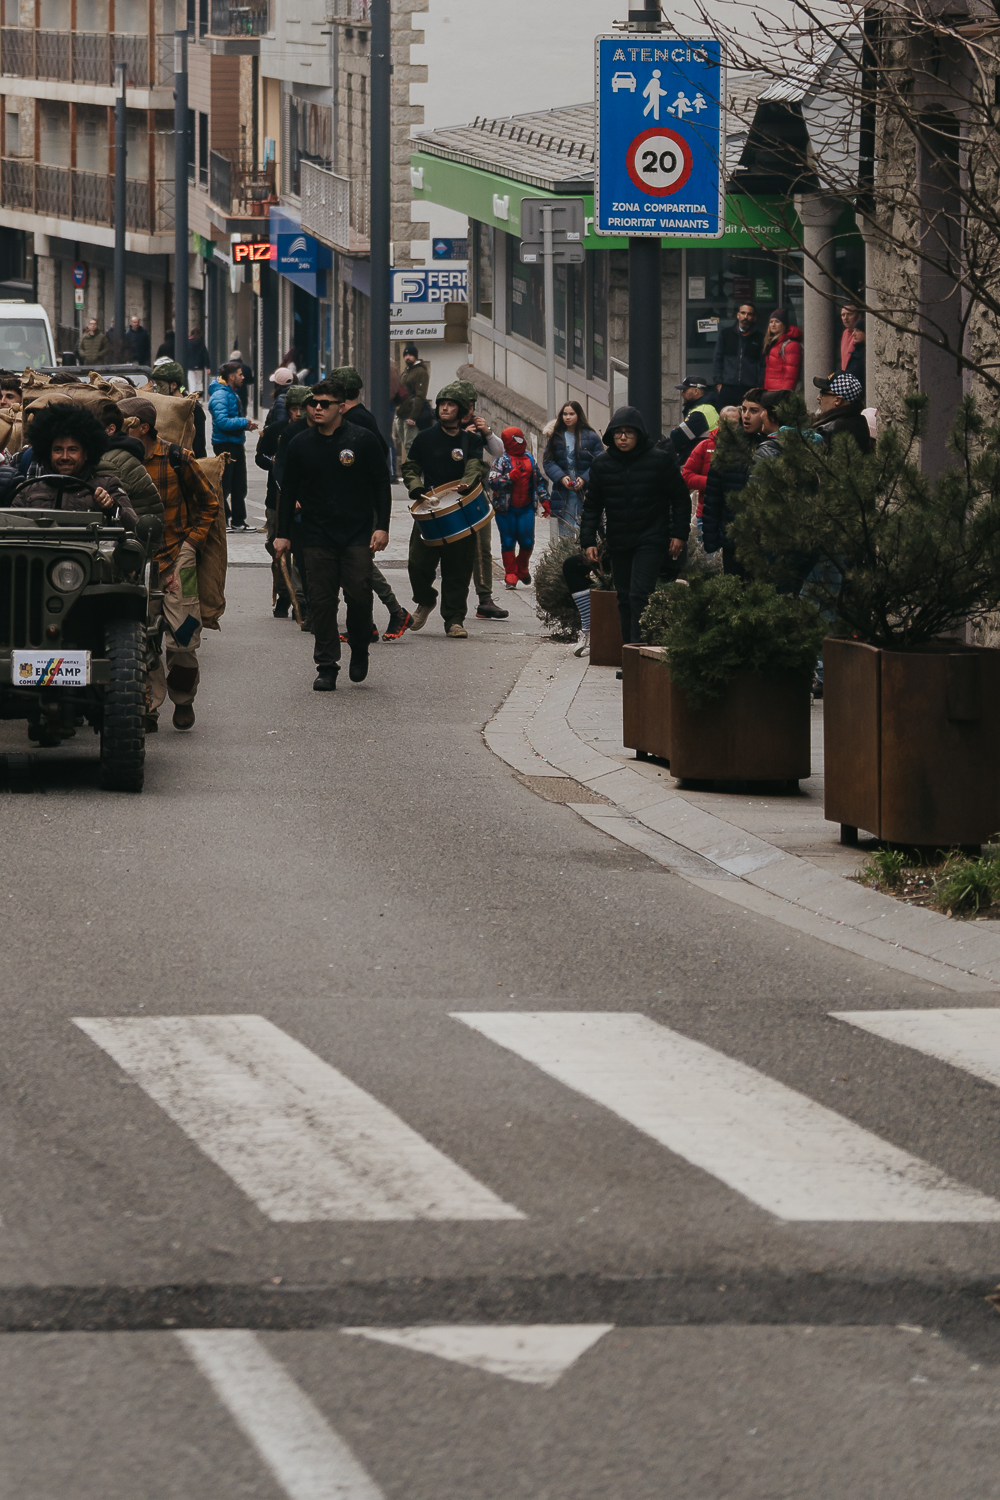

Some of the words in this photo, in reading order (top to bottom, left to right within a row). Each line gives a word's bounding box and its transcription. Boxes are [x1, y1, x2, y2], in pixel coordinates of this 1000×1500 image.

[613, 44, 709, 63] ATENCIÓ
[641, 150, 677, 174] 20
[612, 202, 640, 212] ZONA
[643, 203, 707, 213] COMPARTIDA
[608, 217, 656, 227] PRIORITAT
[660, 218, 709, 229] VIANANTS
[405, 328, 414, 336] de
[35, 667, 81, 677] ENCAMP
